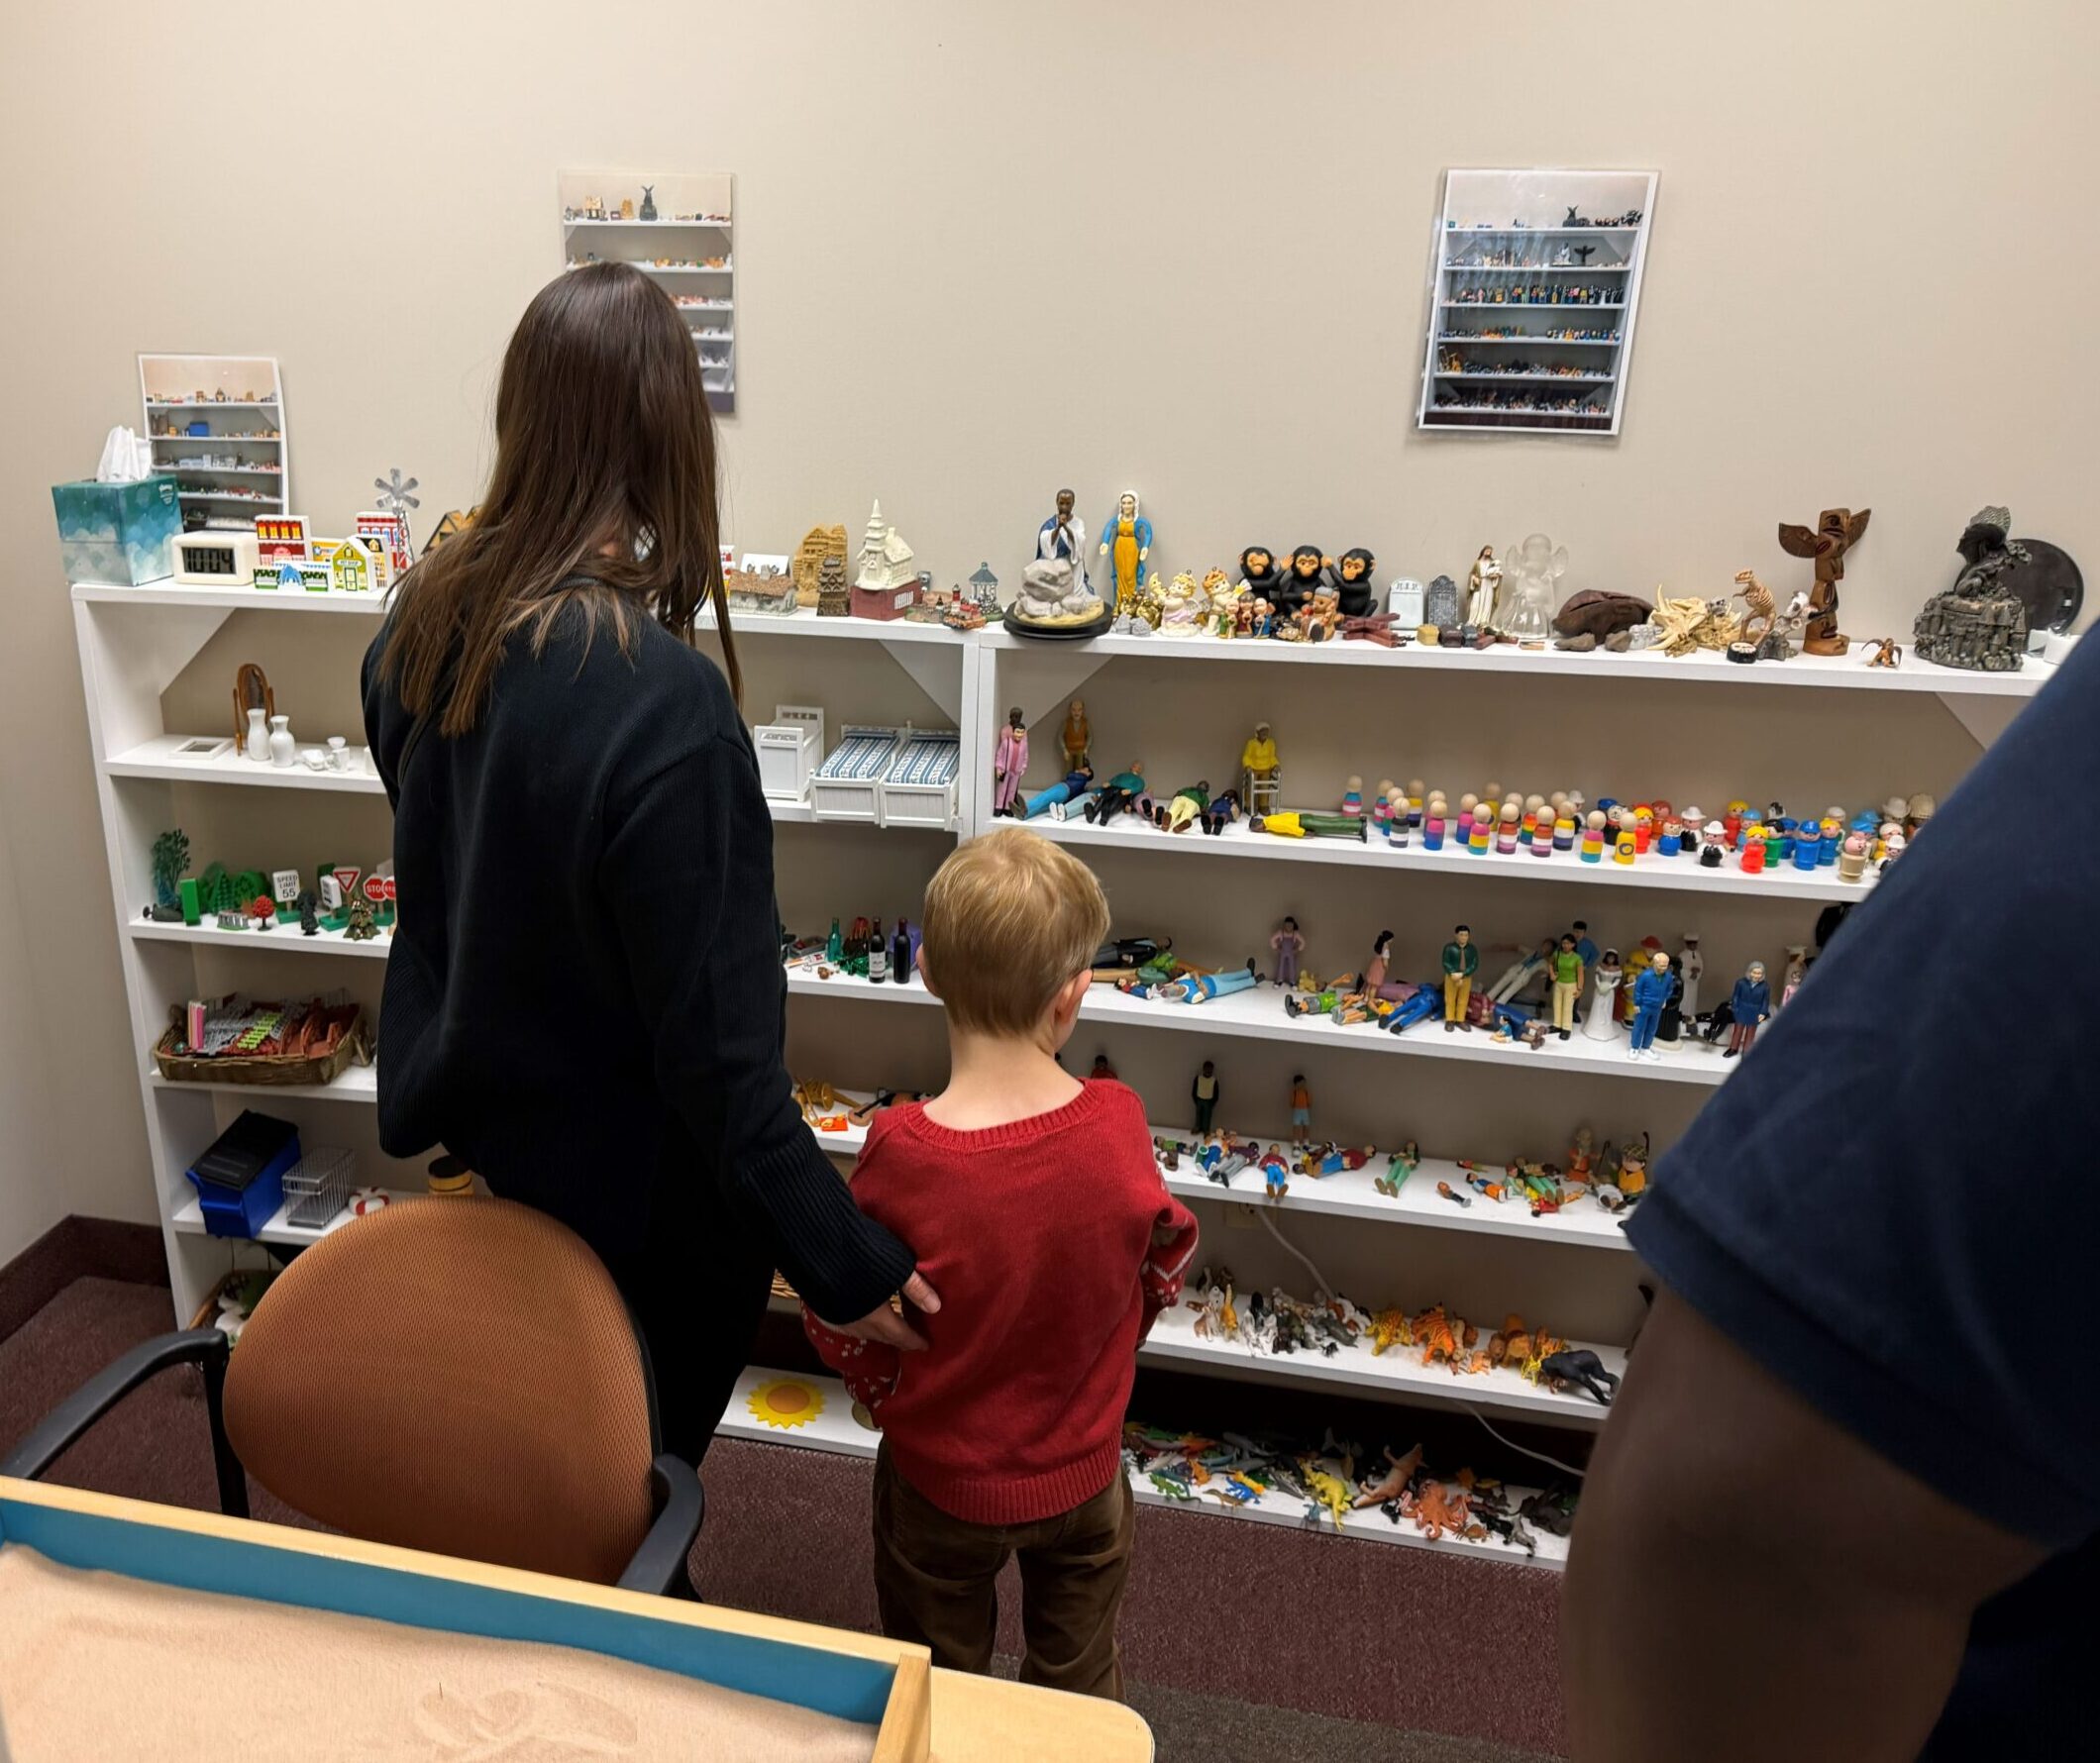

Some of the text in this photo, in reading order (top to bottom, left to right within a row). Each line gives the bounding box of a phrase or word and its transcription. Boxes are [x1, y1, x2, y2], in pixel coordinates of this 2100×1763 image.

[277, 875, 298, 883] SPEED
[282, 887, 296, 898] 55
[367, 884, 381, 893] STO
